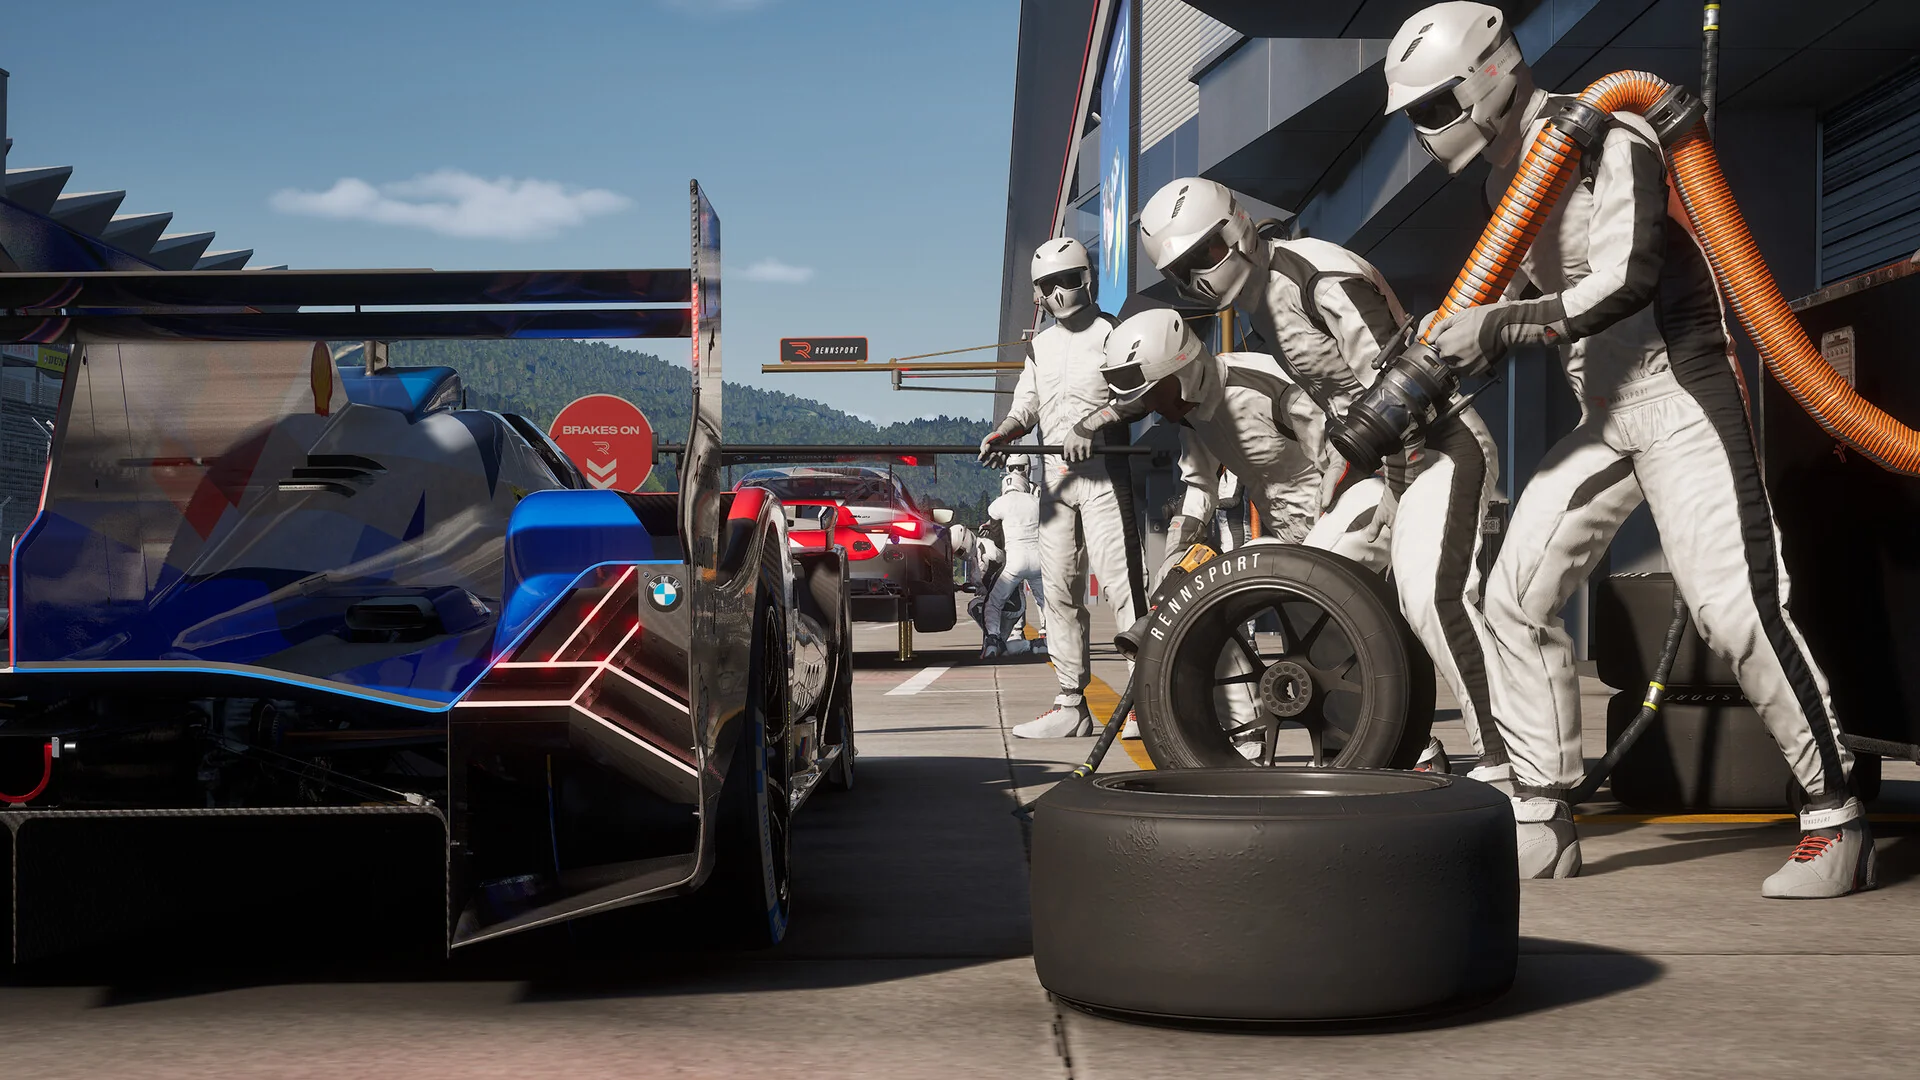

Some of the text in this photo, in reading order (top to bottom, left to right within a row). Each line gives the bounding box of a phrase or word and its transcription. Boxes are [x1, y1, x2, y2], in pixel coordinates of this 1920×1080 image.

[814, 346, 859, 354] RENNSPORT
[48, 356, 66, 367] DUN
[562, 425, 640, 435] BRAKES ON
[649, 576, 682, 589] BMW
[1150, 552, 1261, 641] RENNSPORT
